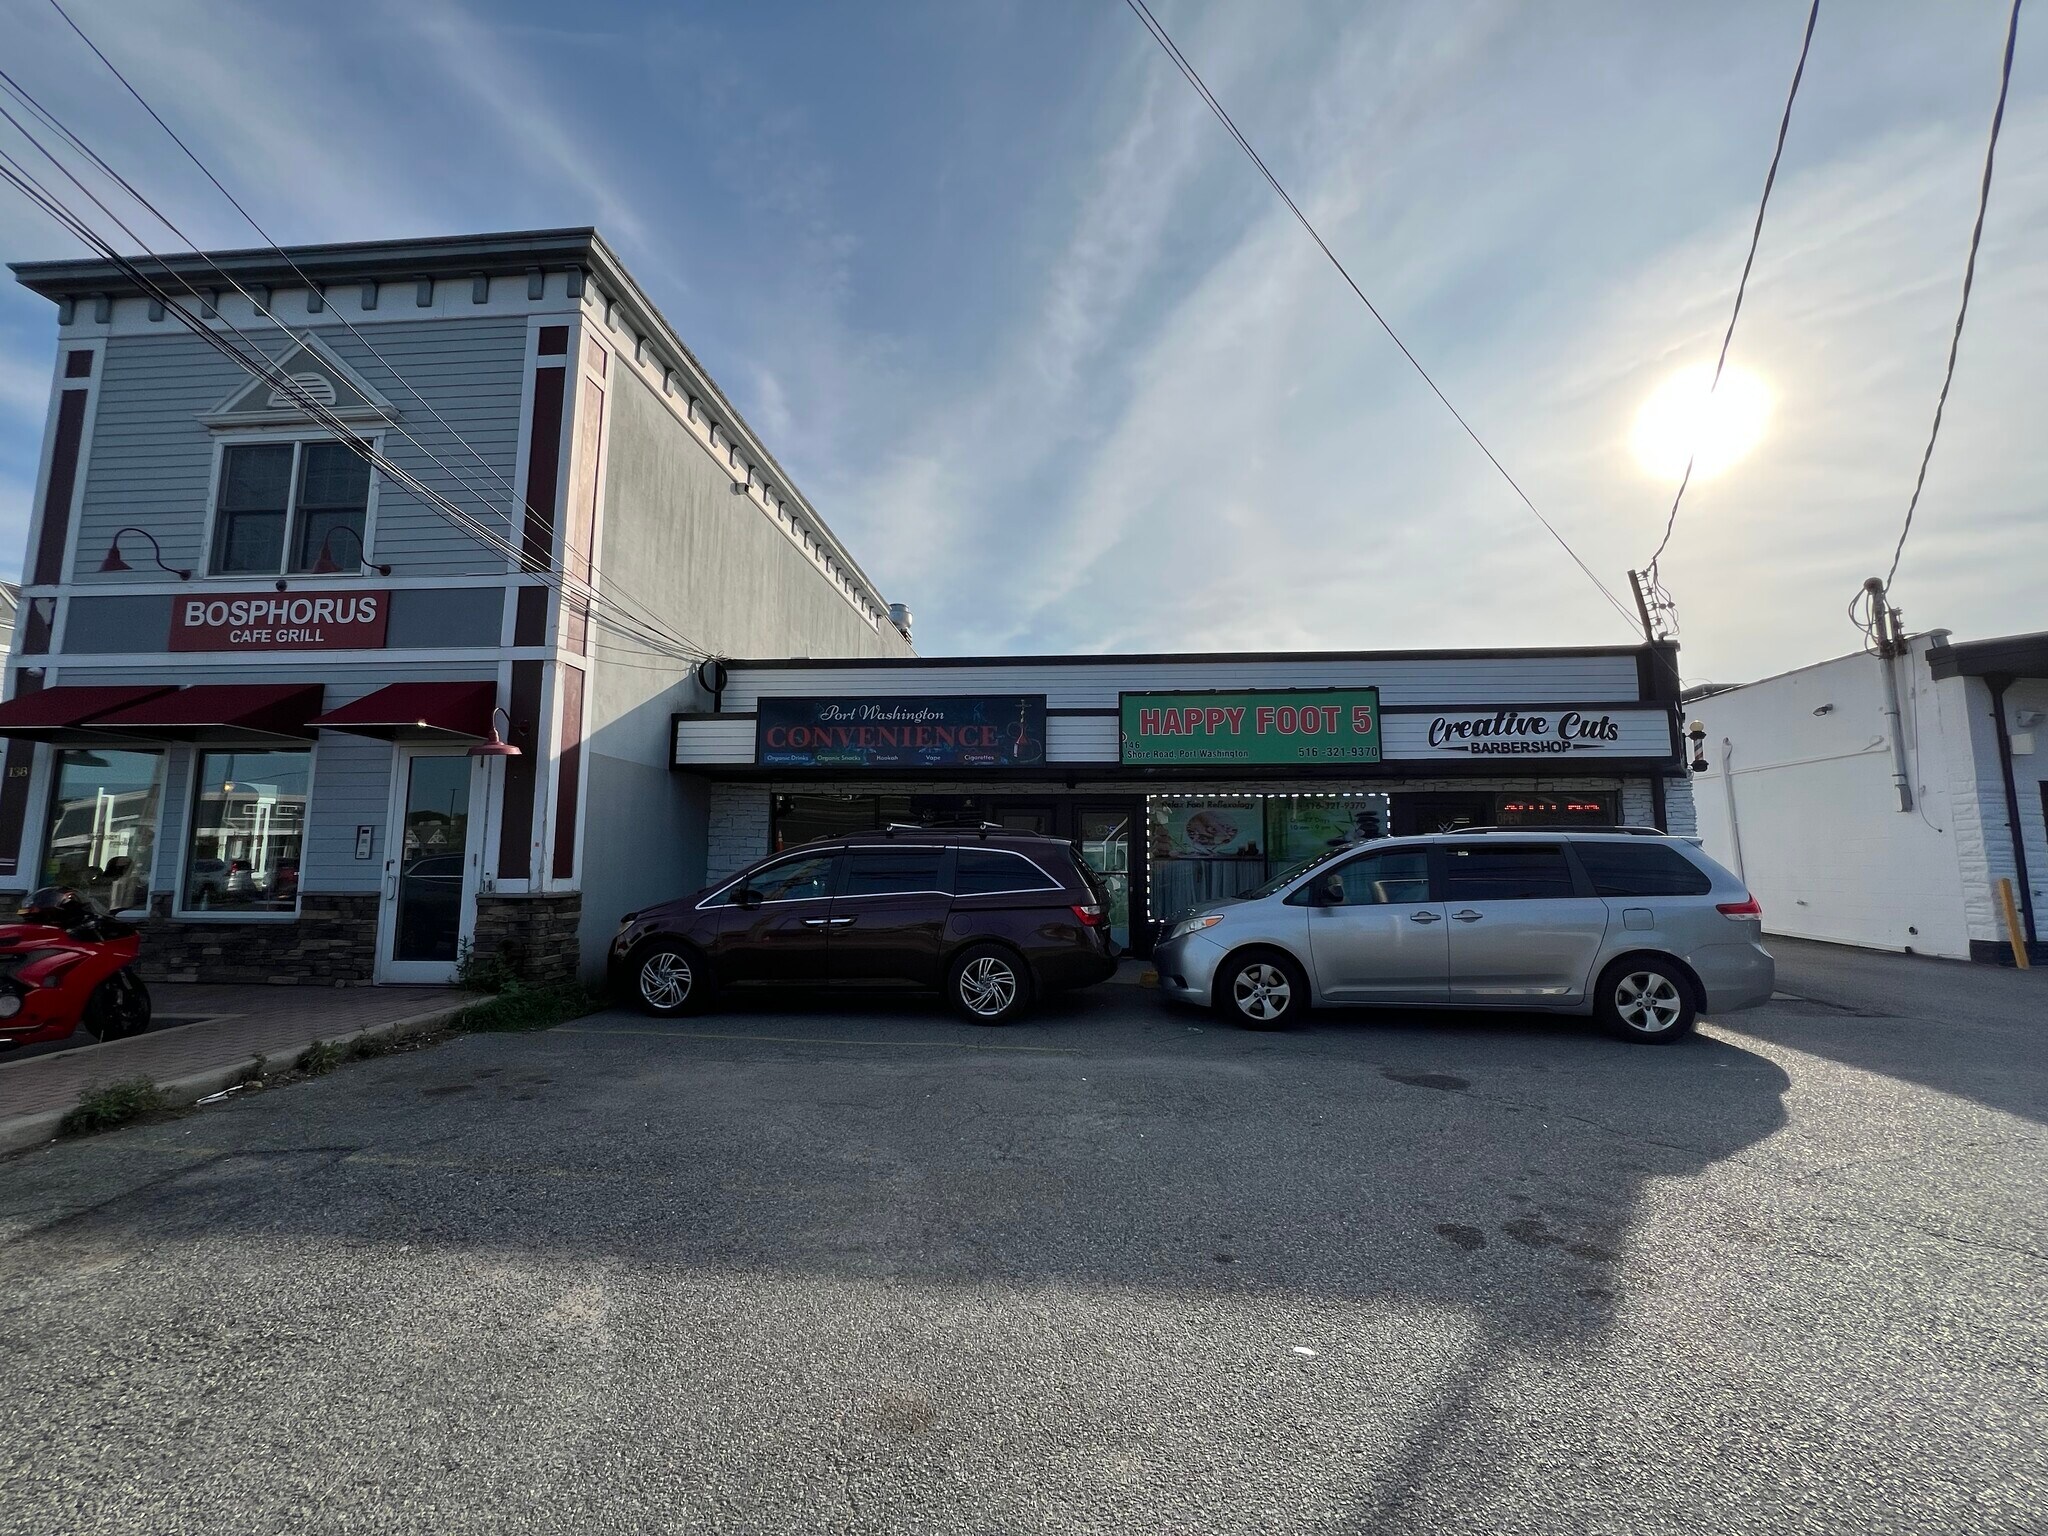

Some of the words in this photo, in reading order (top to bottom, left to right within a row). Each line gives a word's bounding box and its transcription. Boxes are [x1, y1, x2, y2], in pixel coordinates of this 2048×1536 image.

[184, 597, 378, 627] BOSPHORUS
[229, 629, 272, 643] CAFE
[275, 628, 325, 643] GRILL
[819, 704, 856, 722] Port
[858, 704, 945, 723] Washington
[1139, 707, 1246, 736] HAPPY
[1256, 705, 1342, 736] FOOT
[1351, 705, 1373, 735] 5
[1428, 711, 1550, 748] Creative
[1557, 711, 1619, 741] Cuts
[766, 724, 999, 748] CONVENIENCE
[1124, 741, 1141, 749] 146
[1470, 740, 1572, 754] BARBERSHOP
[767, 754, 790, 763] Organic
[790, 754, 809, 762] Drinks
[816, 754, 838, 762] Organic
[925, 754, 941, 762] Vape
[964, 754, 995, 763] Cigarettes
[1127, 750, 1151, 759] Shore
[1153, 750, 1177, 760] Road,
[1179, 749, 1198, 758] Port
[1199, 749, 1249, 759] Washington
[1186, 800, 1205, 809] Foot
[1207, 800, 1255, 810] Reflexology
